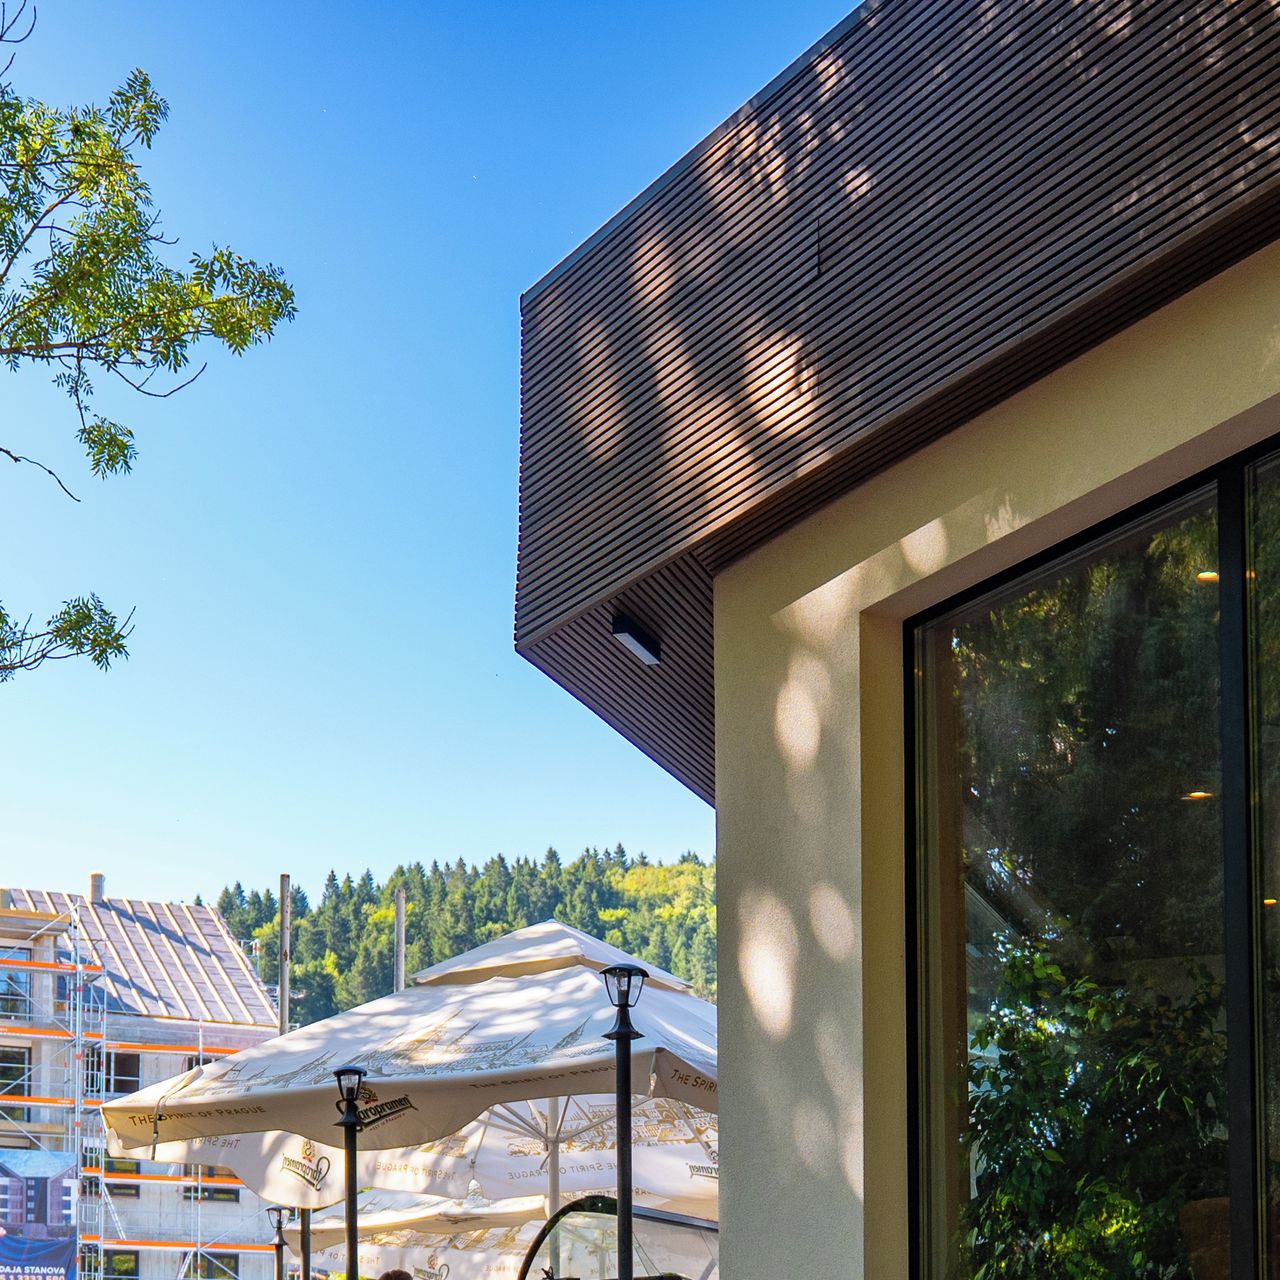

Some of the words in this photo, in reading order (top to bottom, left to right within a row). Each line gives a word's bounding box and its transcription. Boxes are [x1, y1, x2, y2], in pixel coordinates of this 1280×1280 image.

[569, 1064, 617, 1076] PRAGU
[671, 1069, 691, 1085] THE
[692, 1076, 718, 1093] SPIRI
[129, 1114, 154, 1126] THE
[197, 1110, 213, 1118] OF
[215, 1106, 266, 1117] PRAGUE
[24, 1266, 65, 1274] STANOVA
